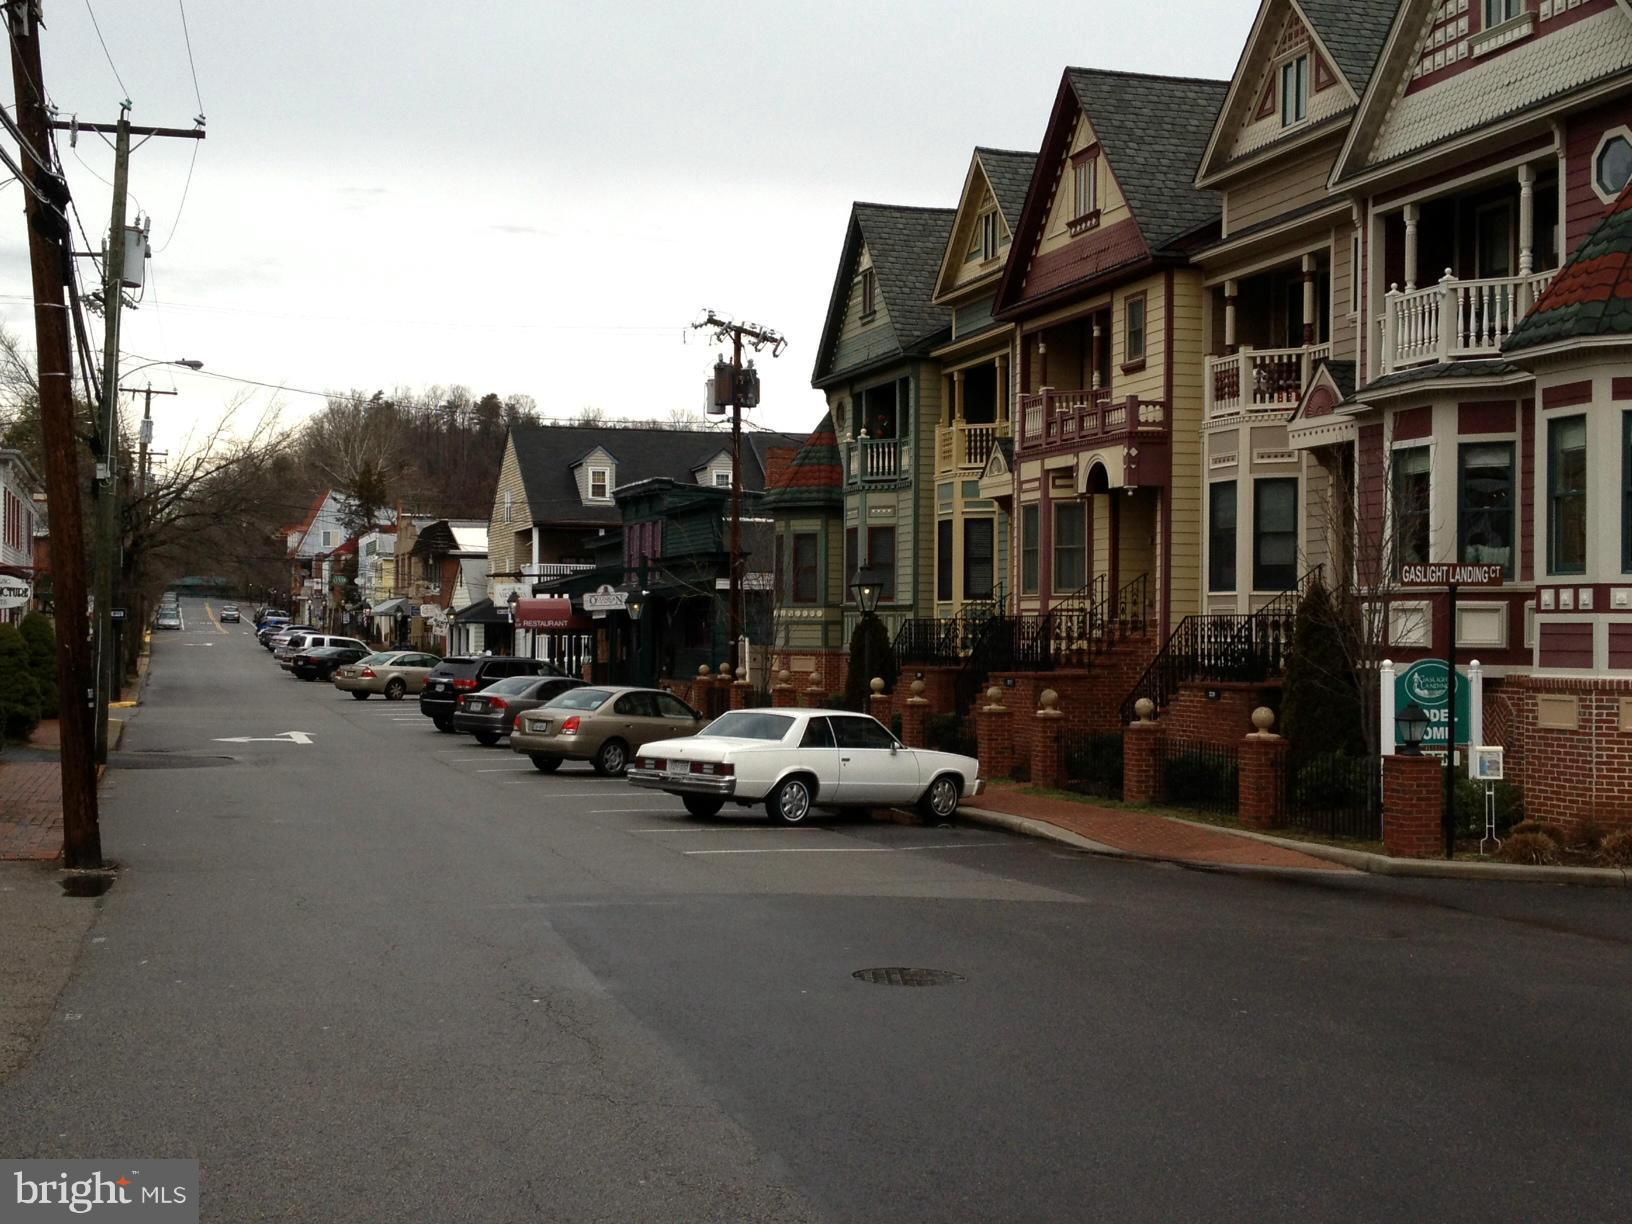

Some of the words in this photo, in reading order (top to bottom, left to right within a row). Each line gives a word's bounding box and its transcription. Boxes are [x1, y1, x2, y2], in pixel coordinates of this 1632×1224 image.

[1402, 565, 1448, 583] GASLIGHT
[1449, 566, 1489, 583] LANDING
[1490, 566, 1501, 578] CT
[523, 619, 569, 627] RESTAURANT
